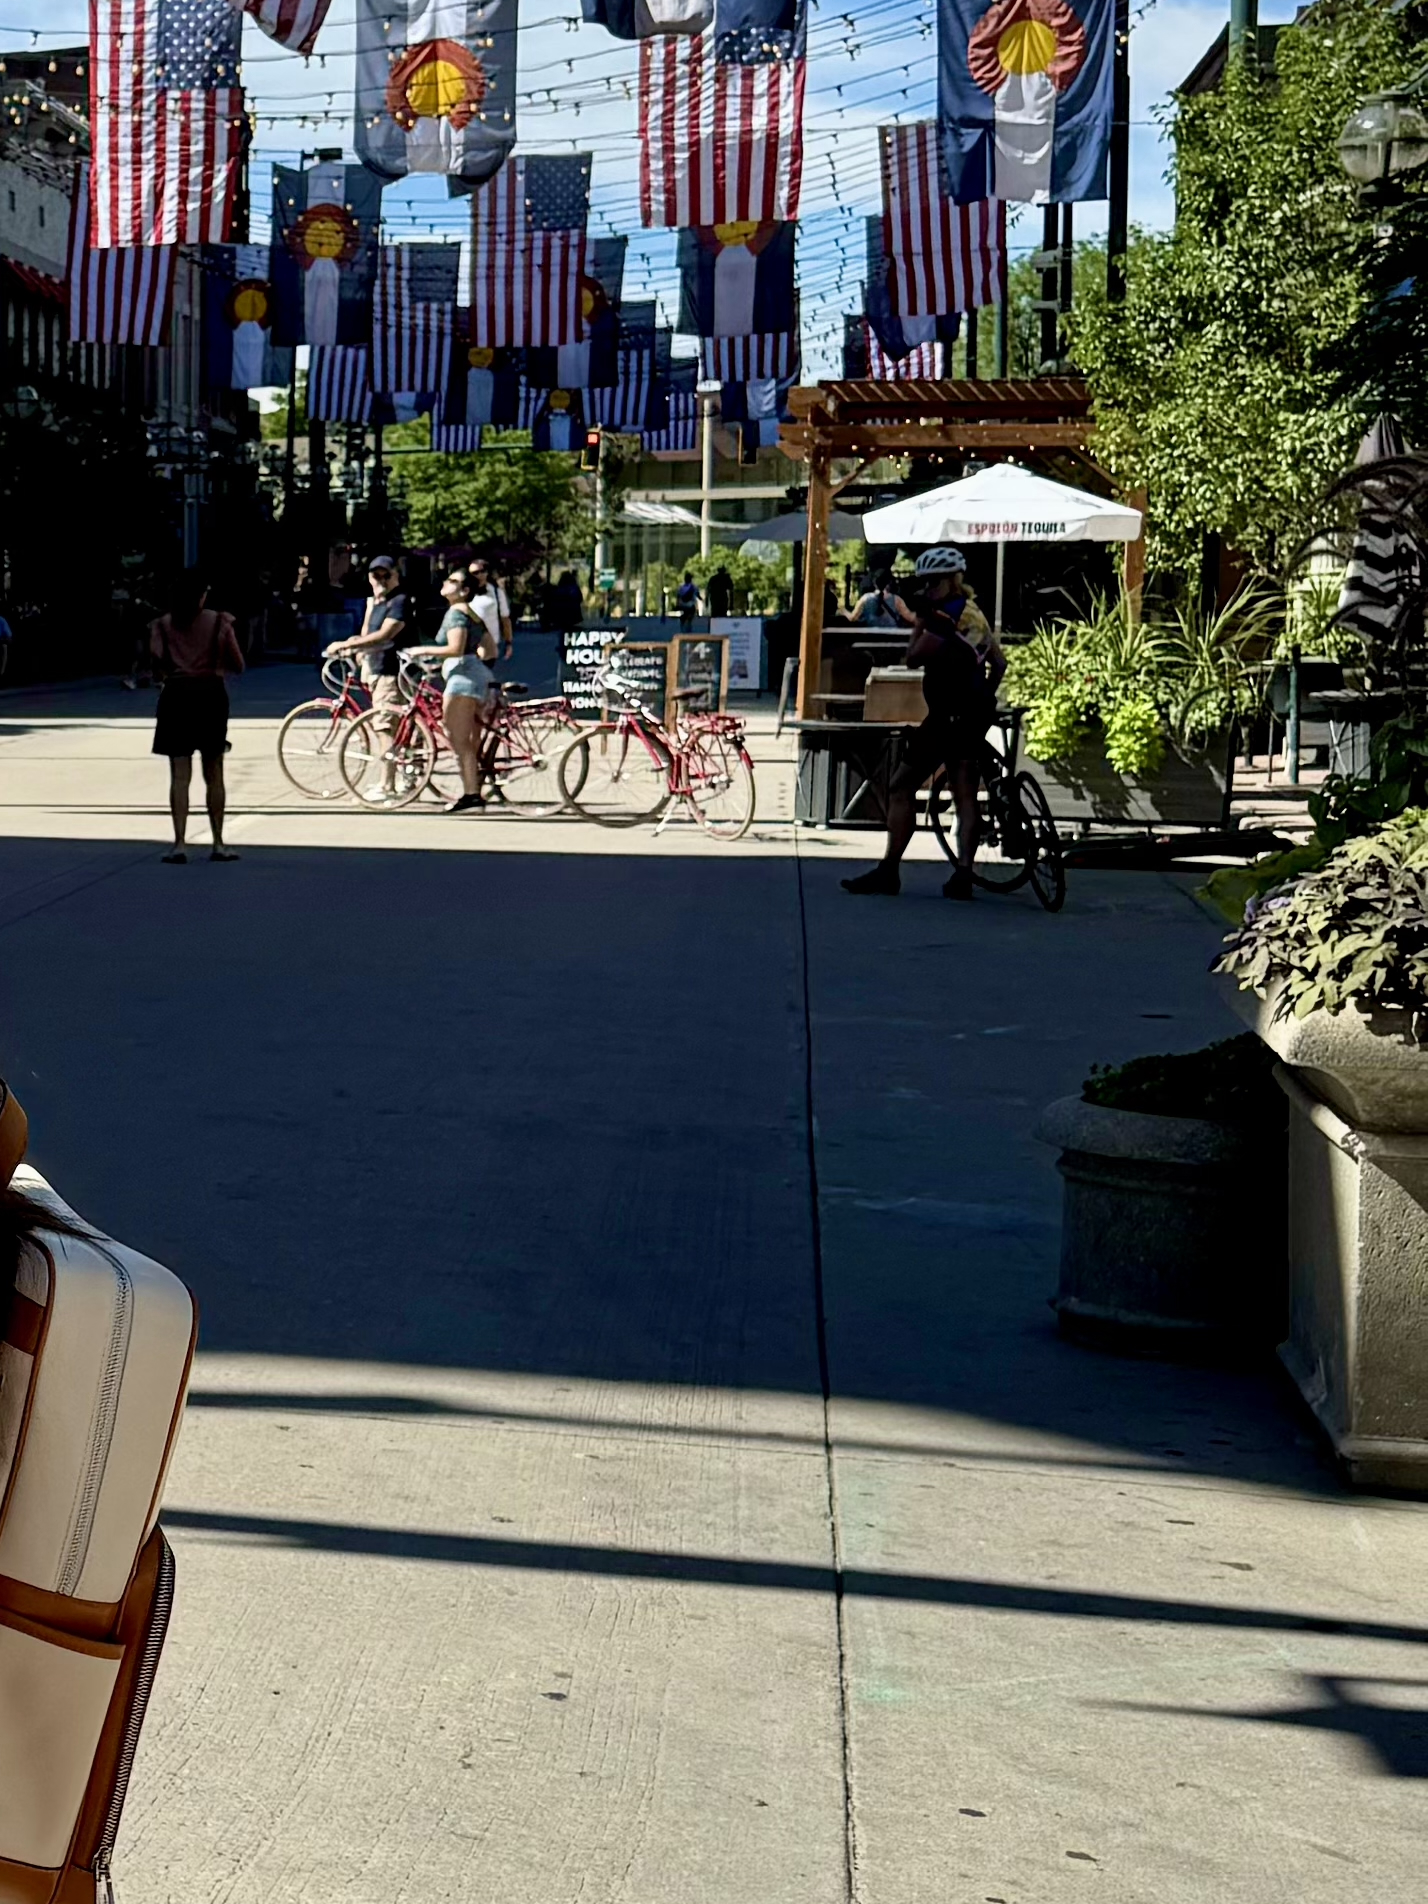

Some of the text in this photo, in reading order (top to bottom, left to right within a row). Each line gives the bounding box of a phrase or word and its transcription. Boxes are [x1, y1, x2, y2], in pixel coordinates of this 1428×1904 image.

[1021, 521, 1066, 534] TEQUILA
[564, 631, 625, 646] HAPPY
[566, 649, 607, 664] HOU
